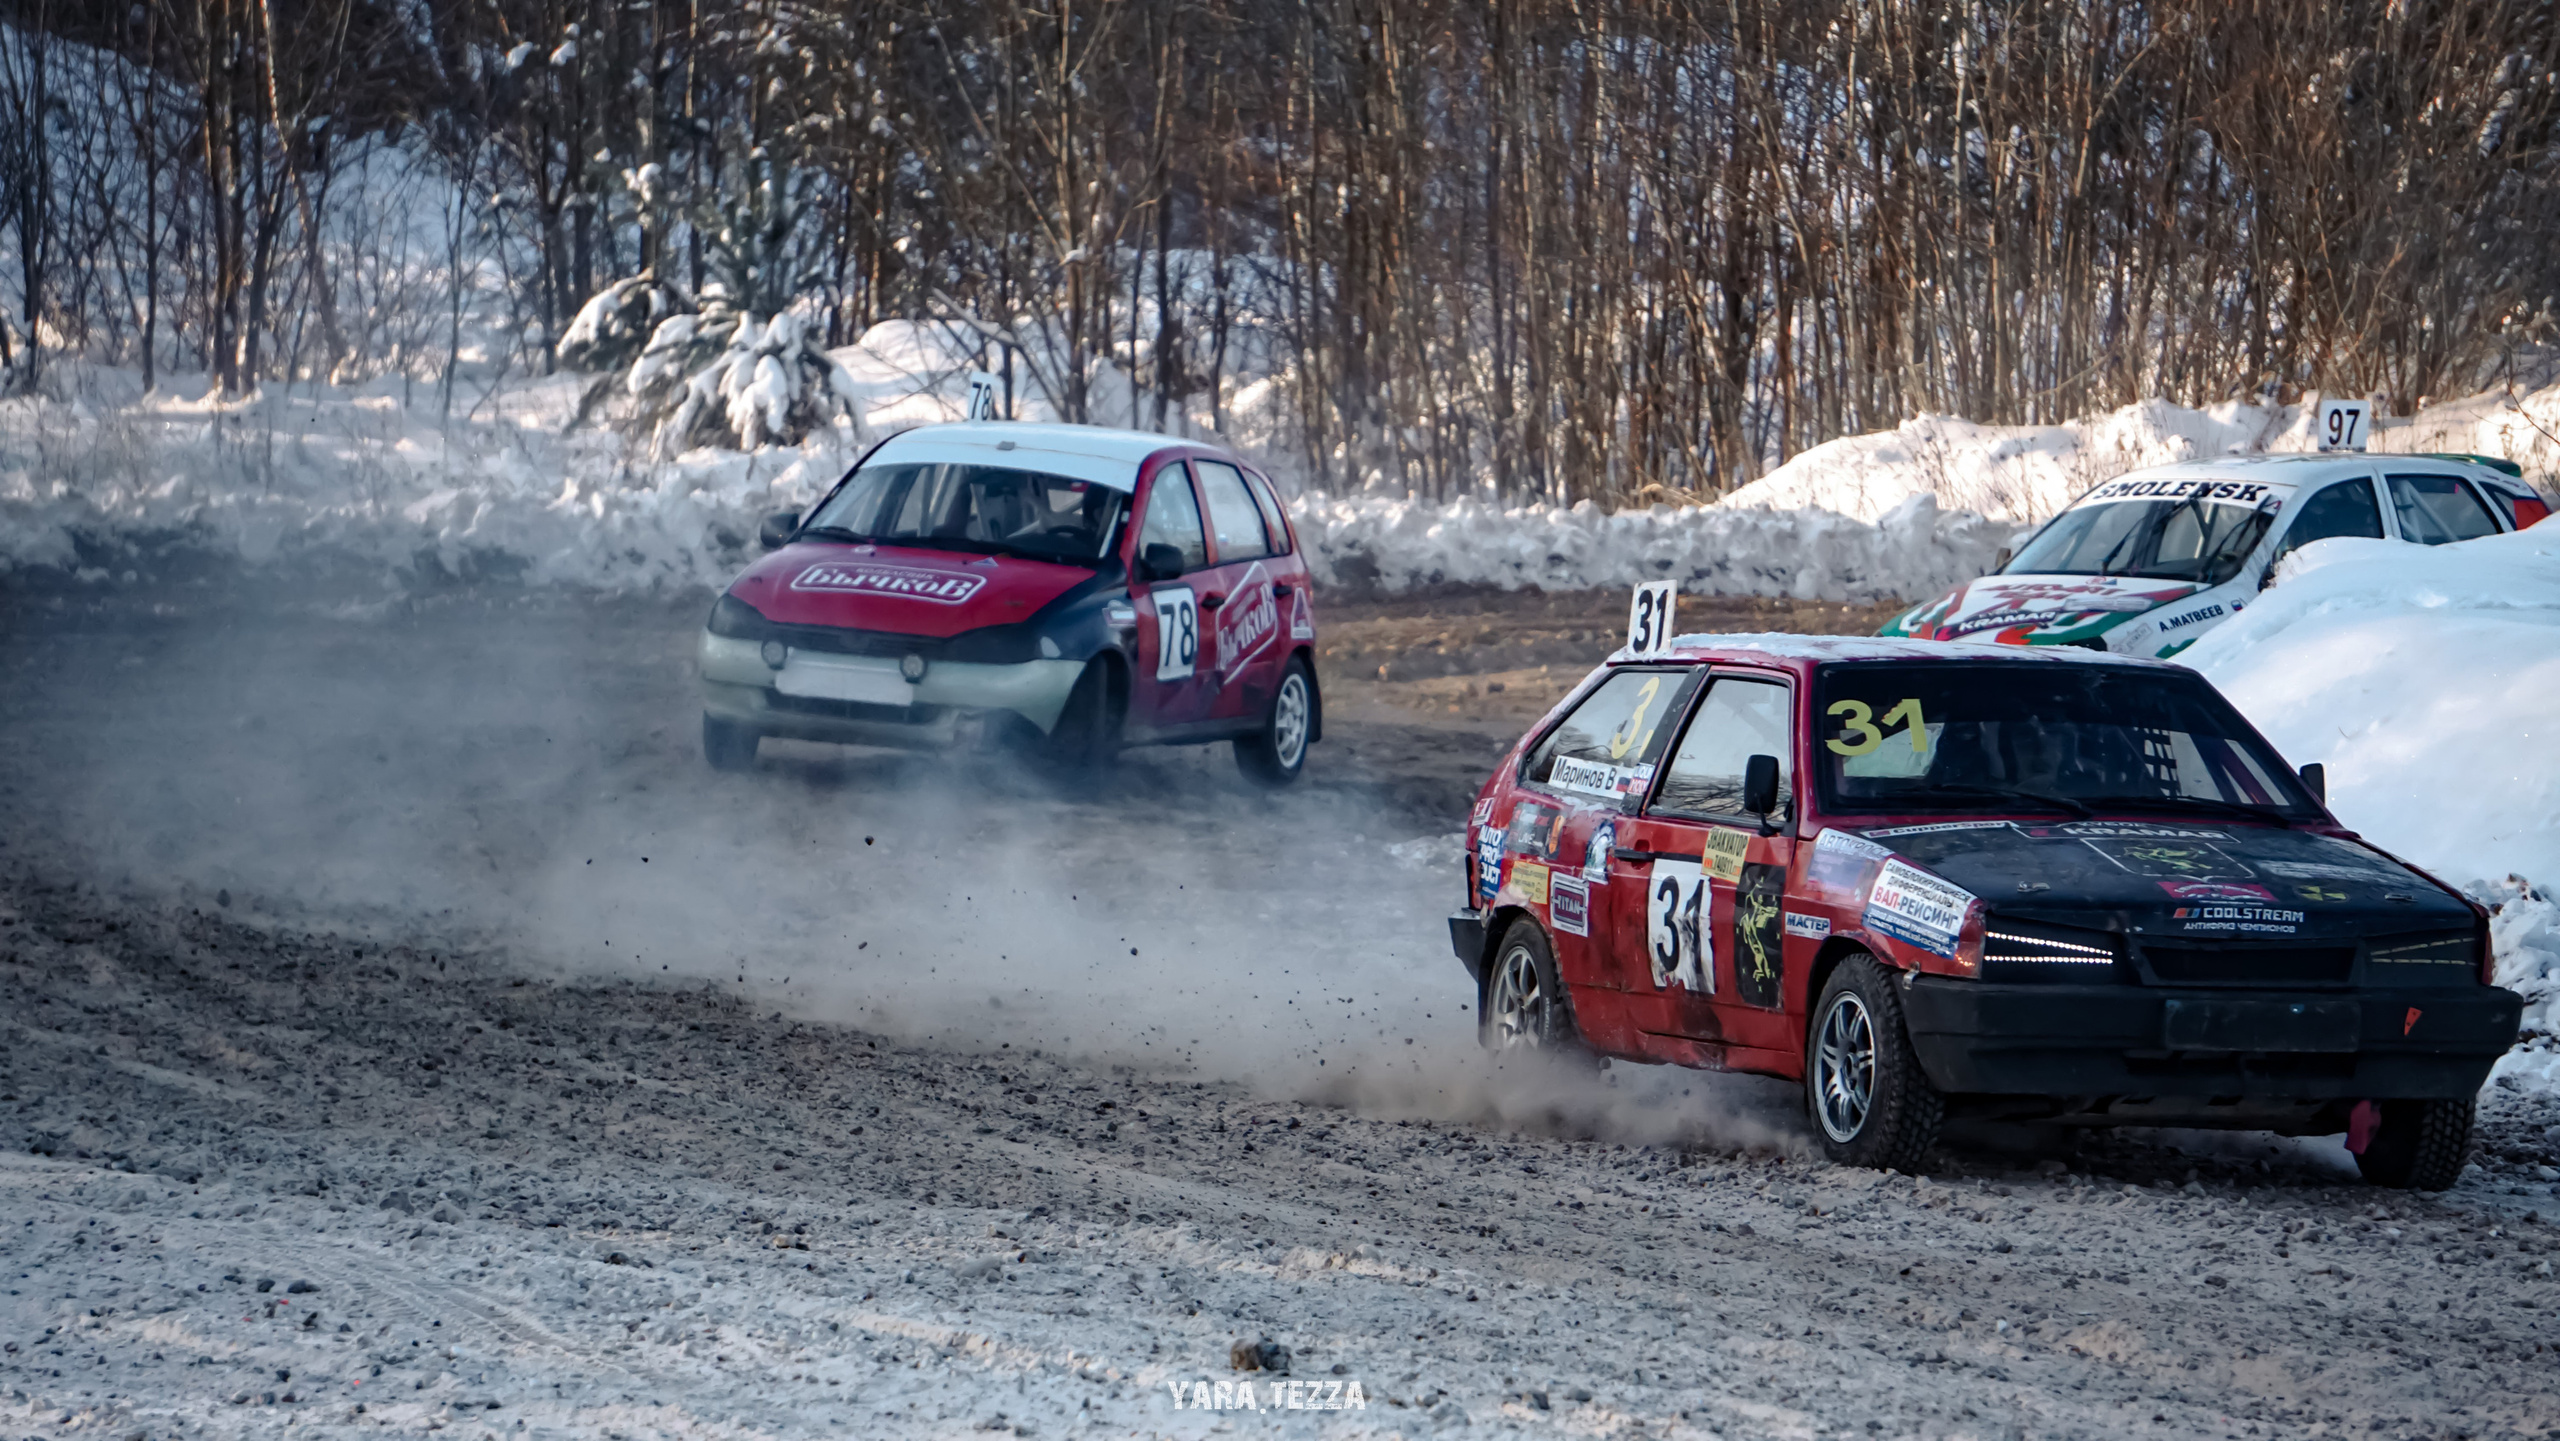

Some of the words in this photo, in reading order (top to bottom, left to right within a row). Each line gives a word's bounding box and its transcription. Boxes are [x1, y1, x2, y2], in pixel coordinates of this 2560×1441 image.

[971, 382, 992, 421] 78
[2328, 408, 2360, 445] 97
[2094, 481, 2268, 502] SMOLENSK
[1159, 600, 1194, 667] 78
[1633, 588, 1669, 653] 31
[1959, 611, 2056, 632] KRAMAR
[1824, 698, 1928, 756] 31
[1552, 757, 1605, 789] Маринов
[1605, 767, 1618, 791] В
[1480, 825, 1502, 846] AUTO
[1707, 829, 1749, 857] ЭВАКУАТОР
[2063, 828, 2226, 840] KRAMAR
[1557, 894, 1580, 915] TITAN
[1874, 885, 1959, 930] ВАЛ-РЕЙСИНГ
[2203, 907, 2304, 922] COOLSTREAM
[1657, 875, 1705, 974] 31
[1787, 914, 1829, 931] МАСТЕР
[2184, 922, 2236, 931] АНТИФРИЗ
[2237, 922, 2296, 933] ЧЕМПИОНОВ
